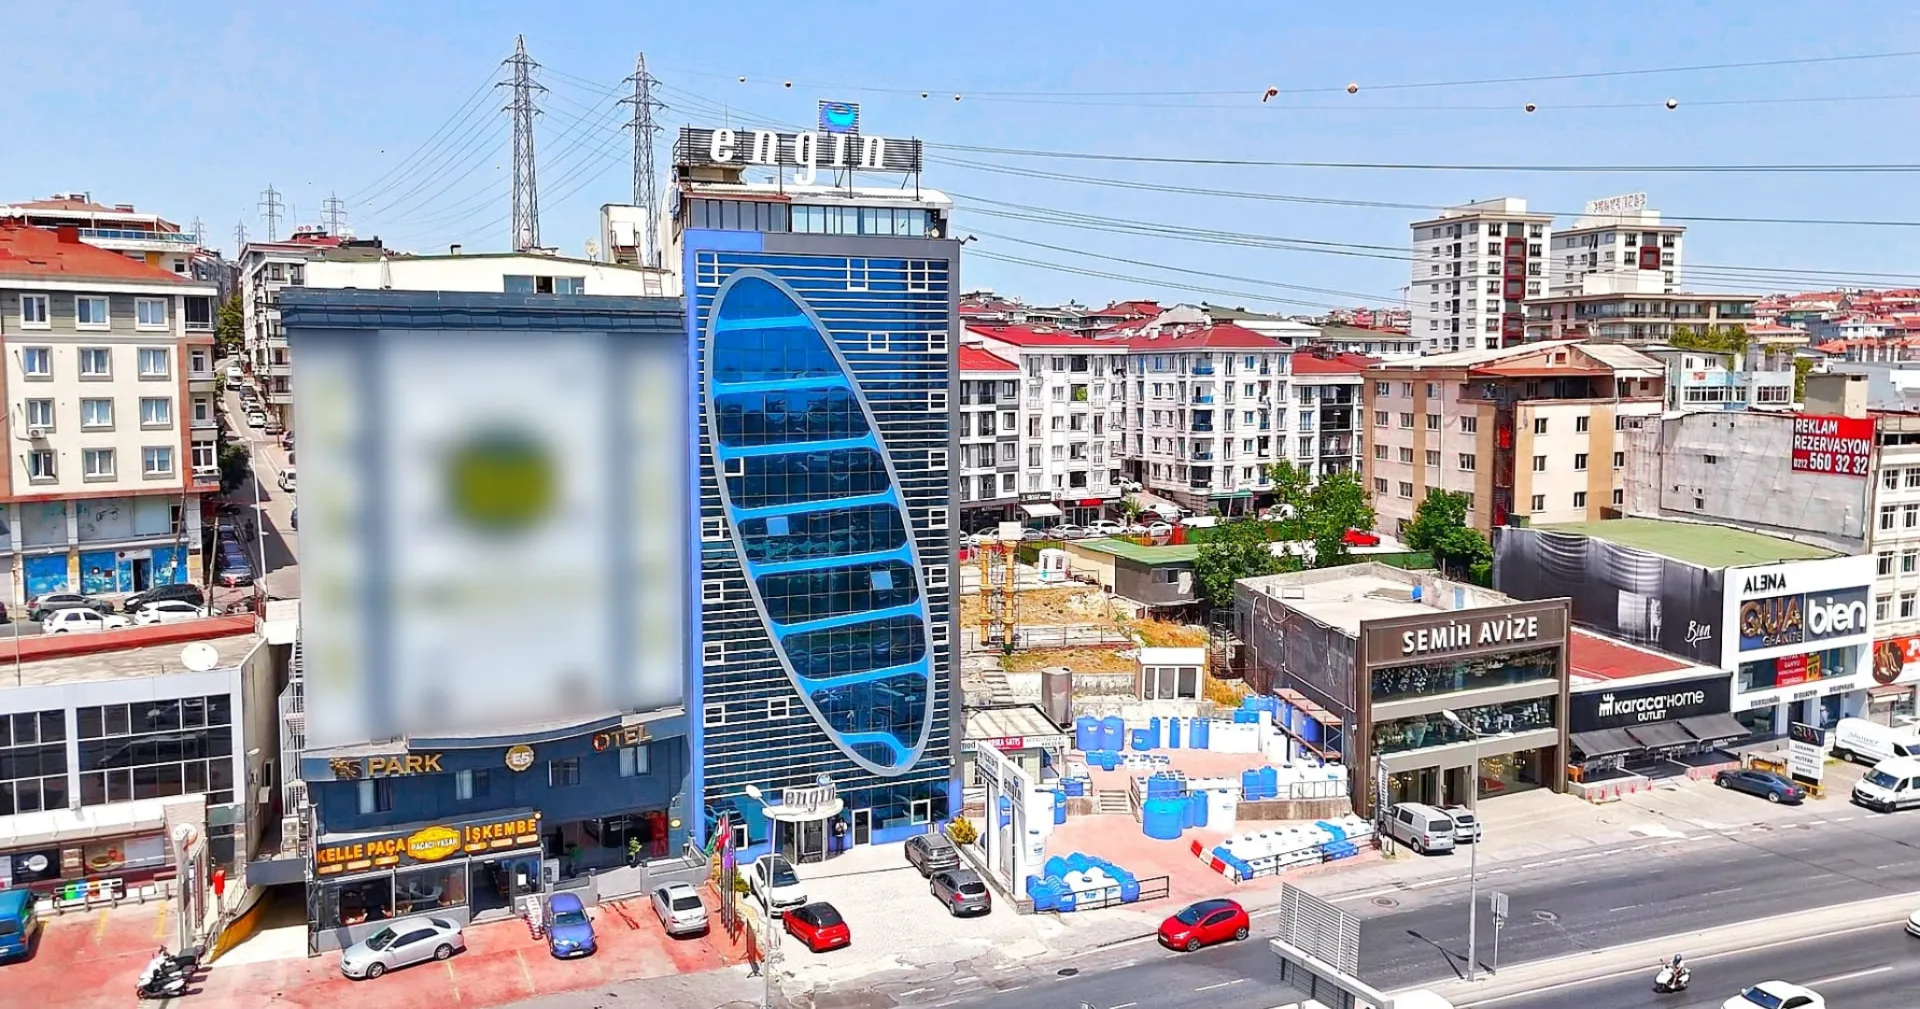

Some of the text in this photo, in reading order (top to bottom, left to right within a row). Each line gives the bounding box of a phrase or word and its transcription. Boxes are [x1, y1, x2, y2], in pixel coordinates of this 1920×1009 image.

[708, 127, 886, 186] engin
[1795, 418, 1838, 435] REKLAM
[1794, 434, 1870, 455] REZERVASYON
[1809, 452, 1832, 471] 560
[1834, 454, 1850, 473] 32
[1853, 456, 1868, 475] 32
[1740, 596, 1802, 638] QUA
[1808, 597, 1867, 636] bien
[1402, 613, 1538, 654] SEMİH AVİZE
[1637, 710, 1667, 722] OUTLET
[367, 752, 444, 777] PARK
[511, 751, 530, 766] E5
[785, 785, 836, 812] engin
[317, 843, 364, 863] KELLE
[367, 837, 406, 858] PAÇA
